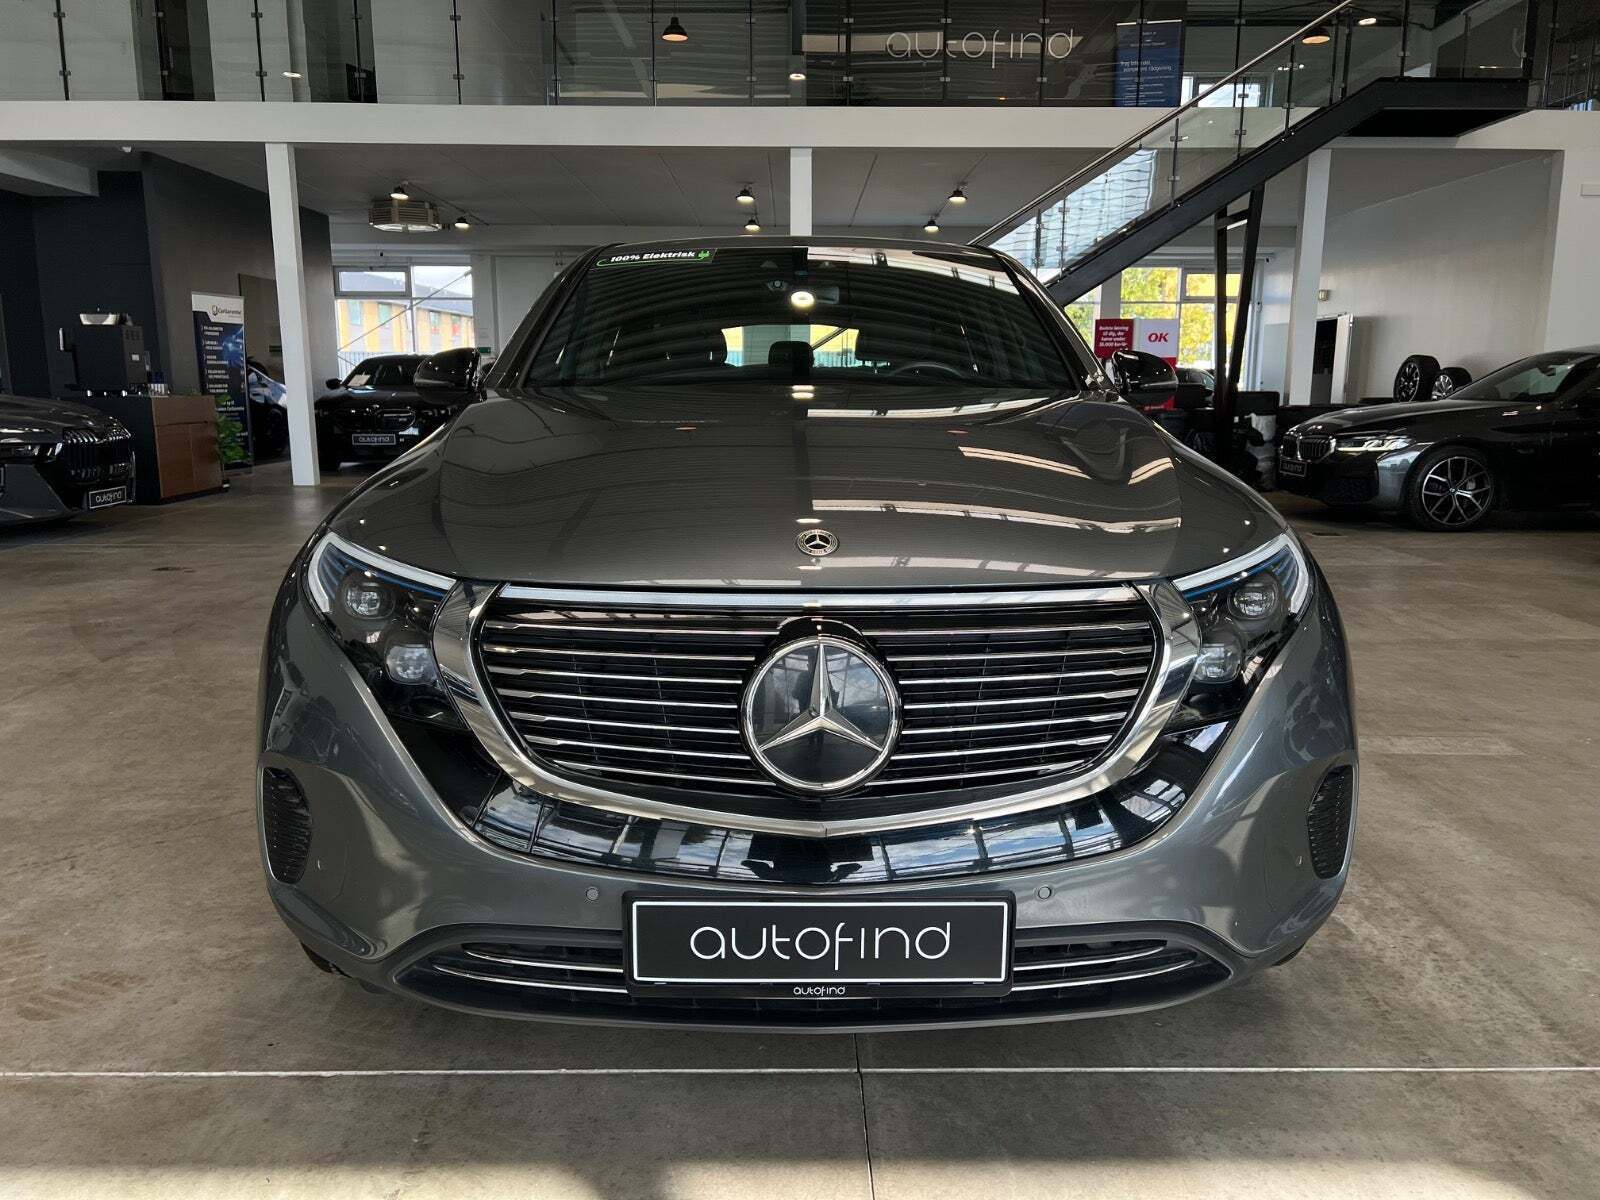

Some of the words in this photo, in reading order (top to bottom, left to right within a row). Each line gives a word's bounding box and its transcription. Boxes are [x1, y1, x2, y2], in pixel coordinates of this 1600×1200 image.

[887, 28, 1073, 69] autofind
[610, 254, 640, 262] 100%
[642, 251, 696, 260] Elektrisk
[1148, 332, 1169, 343] OK
[690, 921, 951, 971] autofind
[793, 986, 846, 997] autofind
